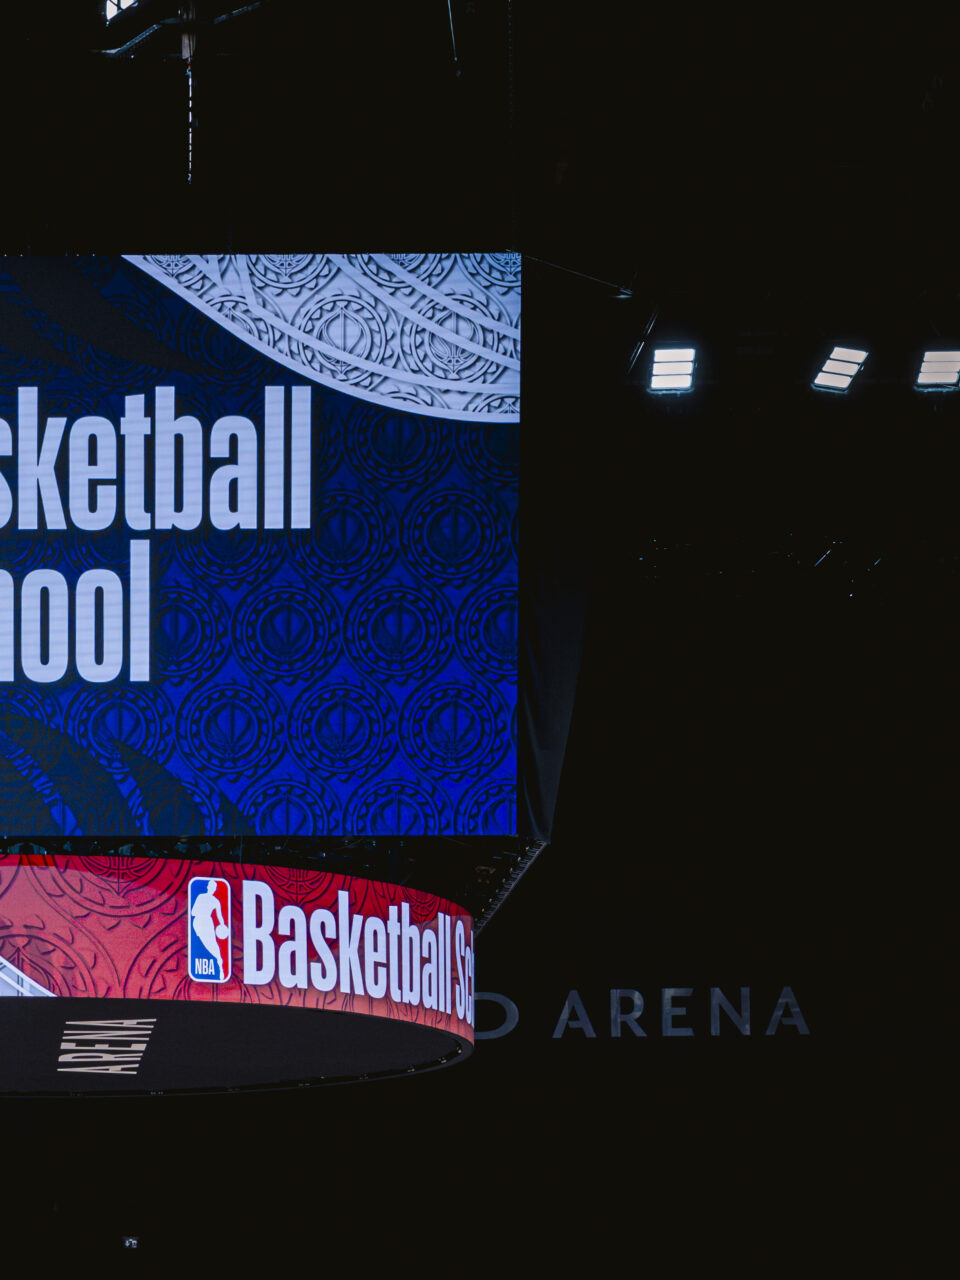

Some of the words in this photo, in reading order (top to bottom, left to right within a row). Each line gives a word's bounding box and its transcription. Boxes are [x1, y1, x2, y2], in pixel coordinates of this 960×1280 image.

[195, 957, 215, 976] NBA
[242, 880, 452, 1015] Basketball
[552, 986, 811, 1038] ARENA
[57, 1018, 157, 1075] ARENA
